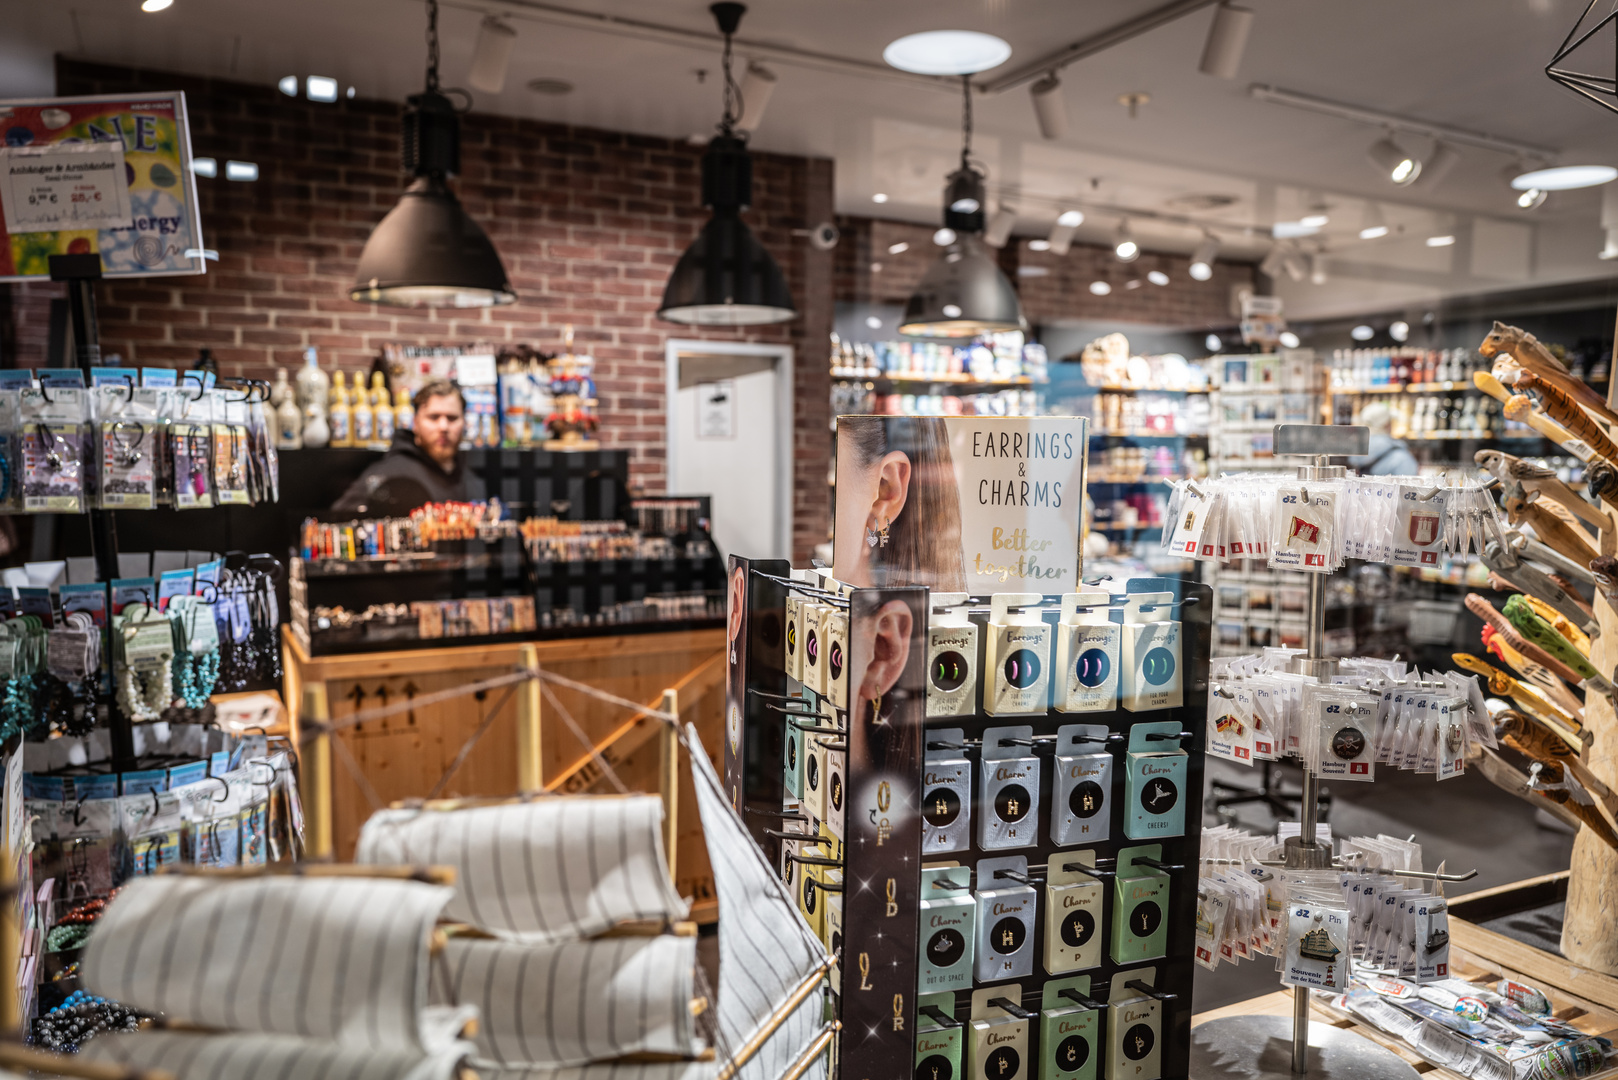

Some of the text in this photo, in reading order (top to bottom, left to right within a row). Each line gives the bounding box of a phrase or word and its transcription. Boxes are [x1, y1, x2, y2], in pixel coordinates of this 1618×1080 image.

[973, 431, 1073, 459] EARRINGS
[1018, 462, 1026, 477] &
[979, 479, 1062, 508] CHARMS
[992, 527, 1052, 551] Better
[973, 553, 1068, 583] together
[932, 633, 969, 648] Earrings
[1007, 631, 1043, 645] Earrings
[1078, 631, 1112, 645] Earrings
[1258, 689, 1269, 698] Pin
[997, 767, 1026, 781] Charm
[1071, 765, 1099, 778] Charm
[1142, 763, 1172, 776] Charm
[925, 773, 956, 786] Charm
[1008, 830, 1016, 838] H
[1082, 825, 1089, 833] H
[938, 835, 946, 844] H
[1133, 887, 1160, 899] Charm
[1063, 895, 1091, 908] Charm
[993, 903, 1022, 916] Charm
[930, 915, 962, 927] Charm
[1328, 914, 1342, 924] Pin
[1074, 953, 1081, 962] P
[1004, 961, 1012, 970] H
[926, 973, 964, 984] OUT OF SPACE
[1291, 967, 1322, 979] Souvenir
[1124, 1010, 1150, 1024] Charm
[1058, 1021, 1087, 1034] Charm
[987, 1032, 1016, 1046] Charm
[917, 1040, 949, 1053] Charm
[1135, 1066, 1142, 1075] P
